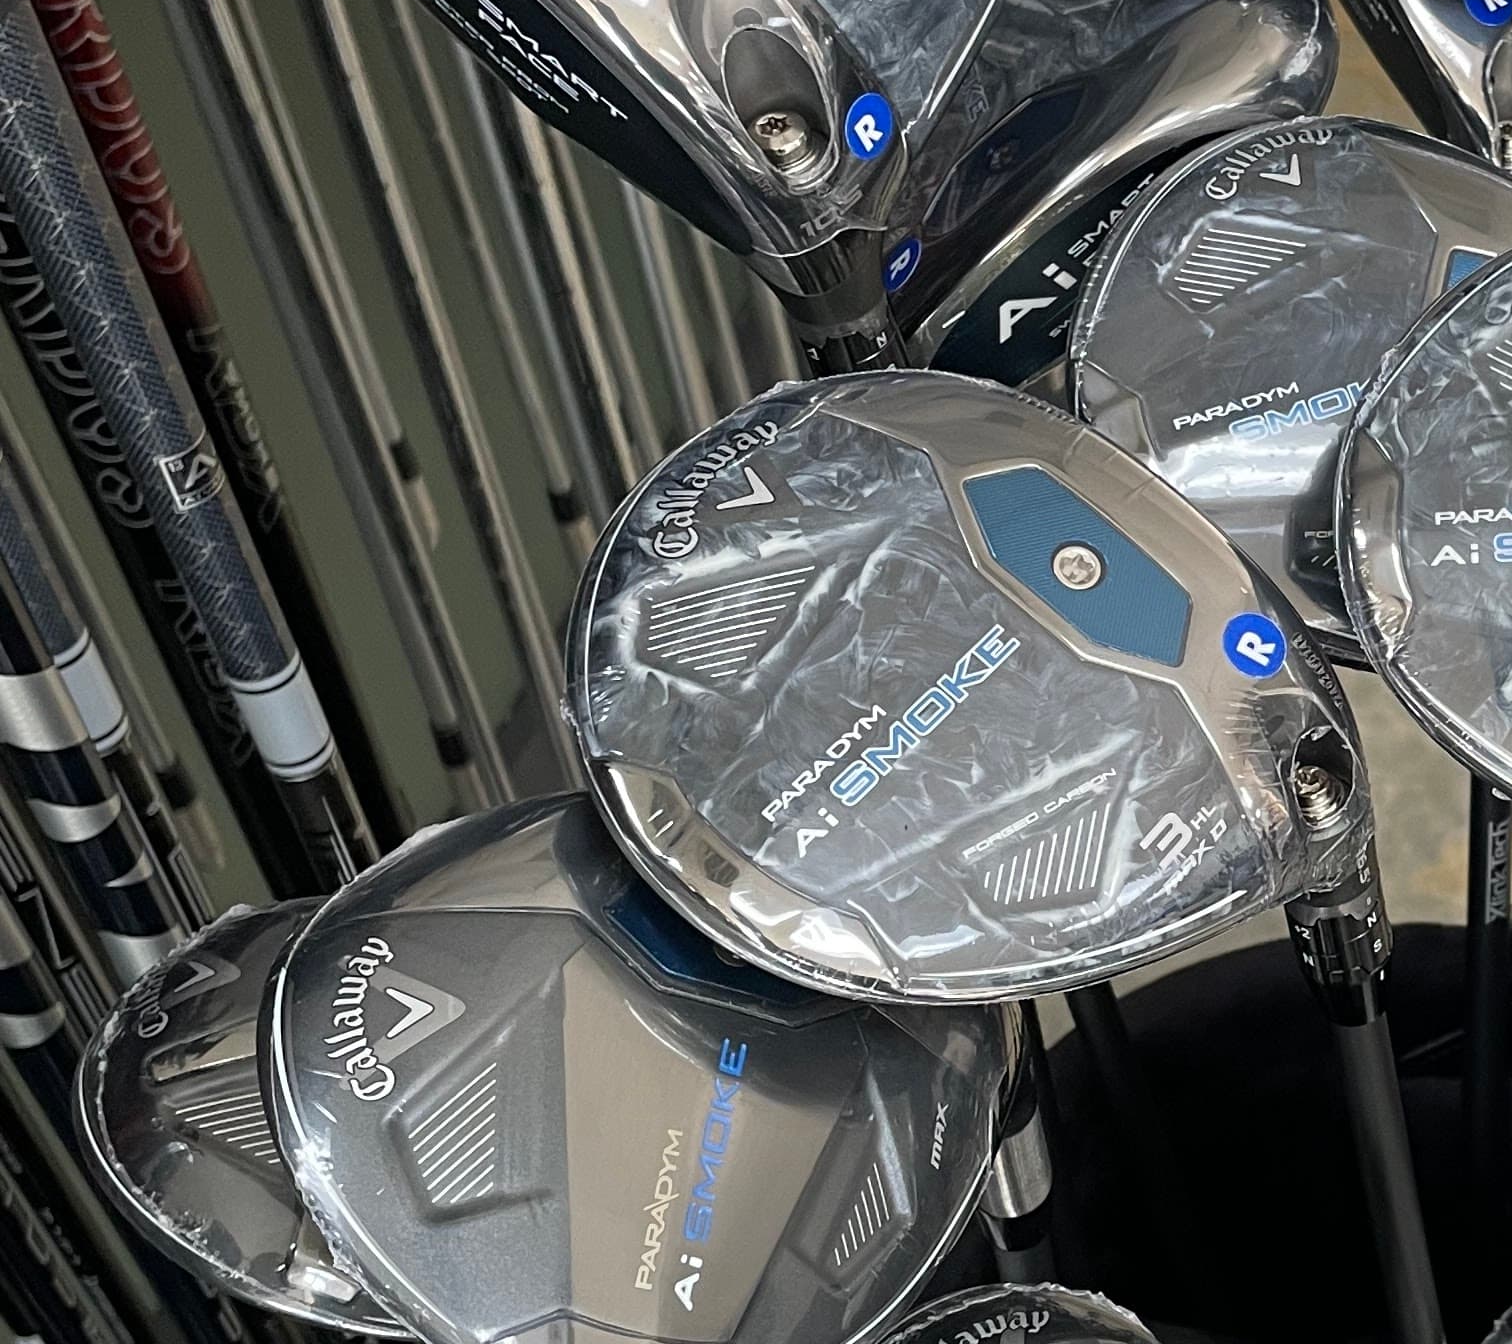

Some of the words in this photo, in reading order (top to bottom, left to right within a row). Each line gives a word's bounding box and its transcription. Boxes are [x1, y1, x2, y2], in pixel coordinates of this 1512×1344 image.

[478, 8, 579, 102] FACE
[854, 114, 884, 153] R
[1205, 127, 1336, 202] Callaway
[890, 247, 911, 281] R
[1000, 262, 1078, 345] Ai
[1172, 381, 1301, 432] PARADYM
[653, 419, 779, 559] Callaway
[1431, 544, 1480, 567] Ai
[1236, 630, 1277, 668] R
[760, 704, 887, 824] PARADYM
[792, 807, 840, 858] Ai
[830, 623, 1021, 808] SMOKE
[962, 811, 1039, 859] FORGED
[1042, 767, 1117, 816] CARBON
[1139, 812, 1192, 870] 3
[1190, 806, 1217, 831] HL
[1209, 818, 1228, 843] D
[323, 936, 396, 1101] Callaway
[684, 1037, 749, 1244] SMOKE
[930, 1102, 949, 1170] MAX
[634, 1128, 684, 1291] PARADYM
[674, 1253, 704, 1312] Ai
